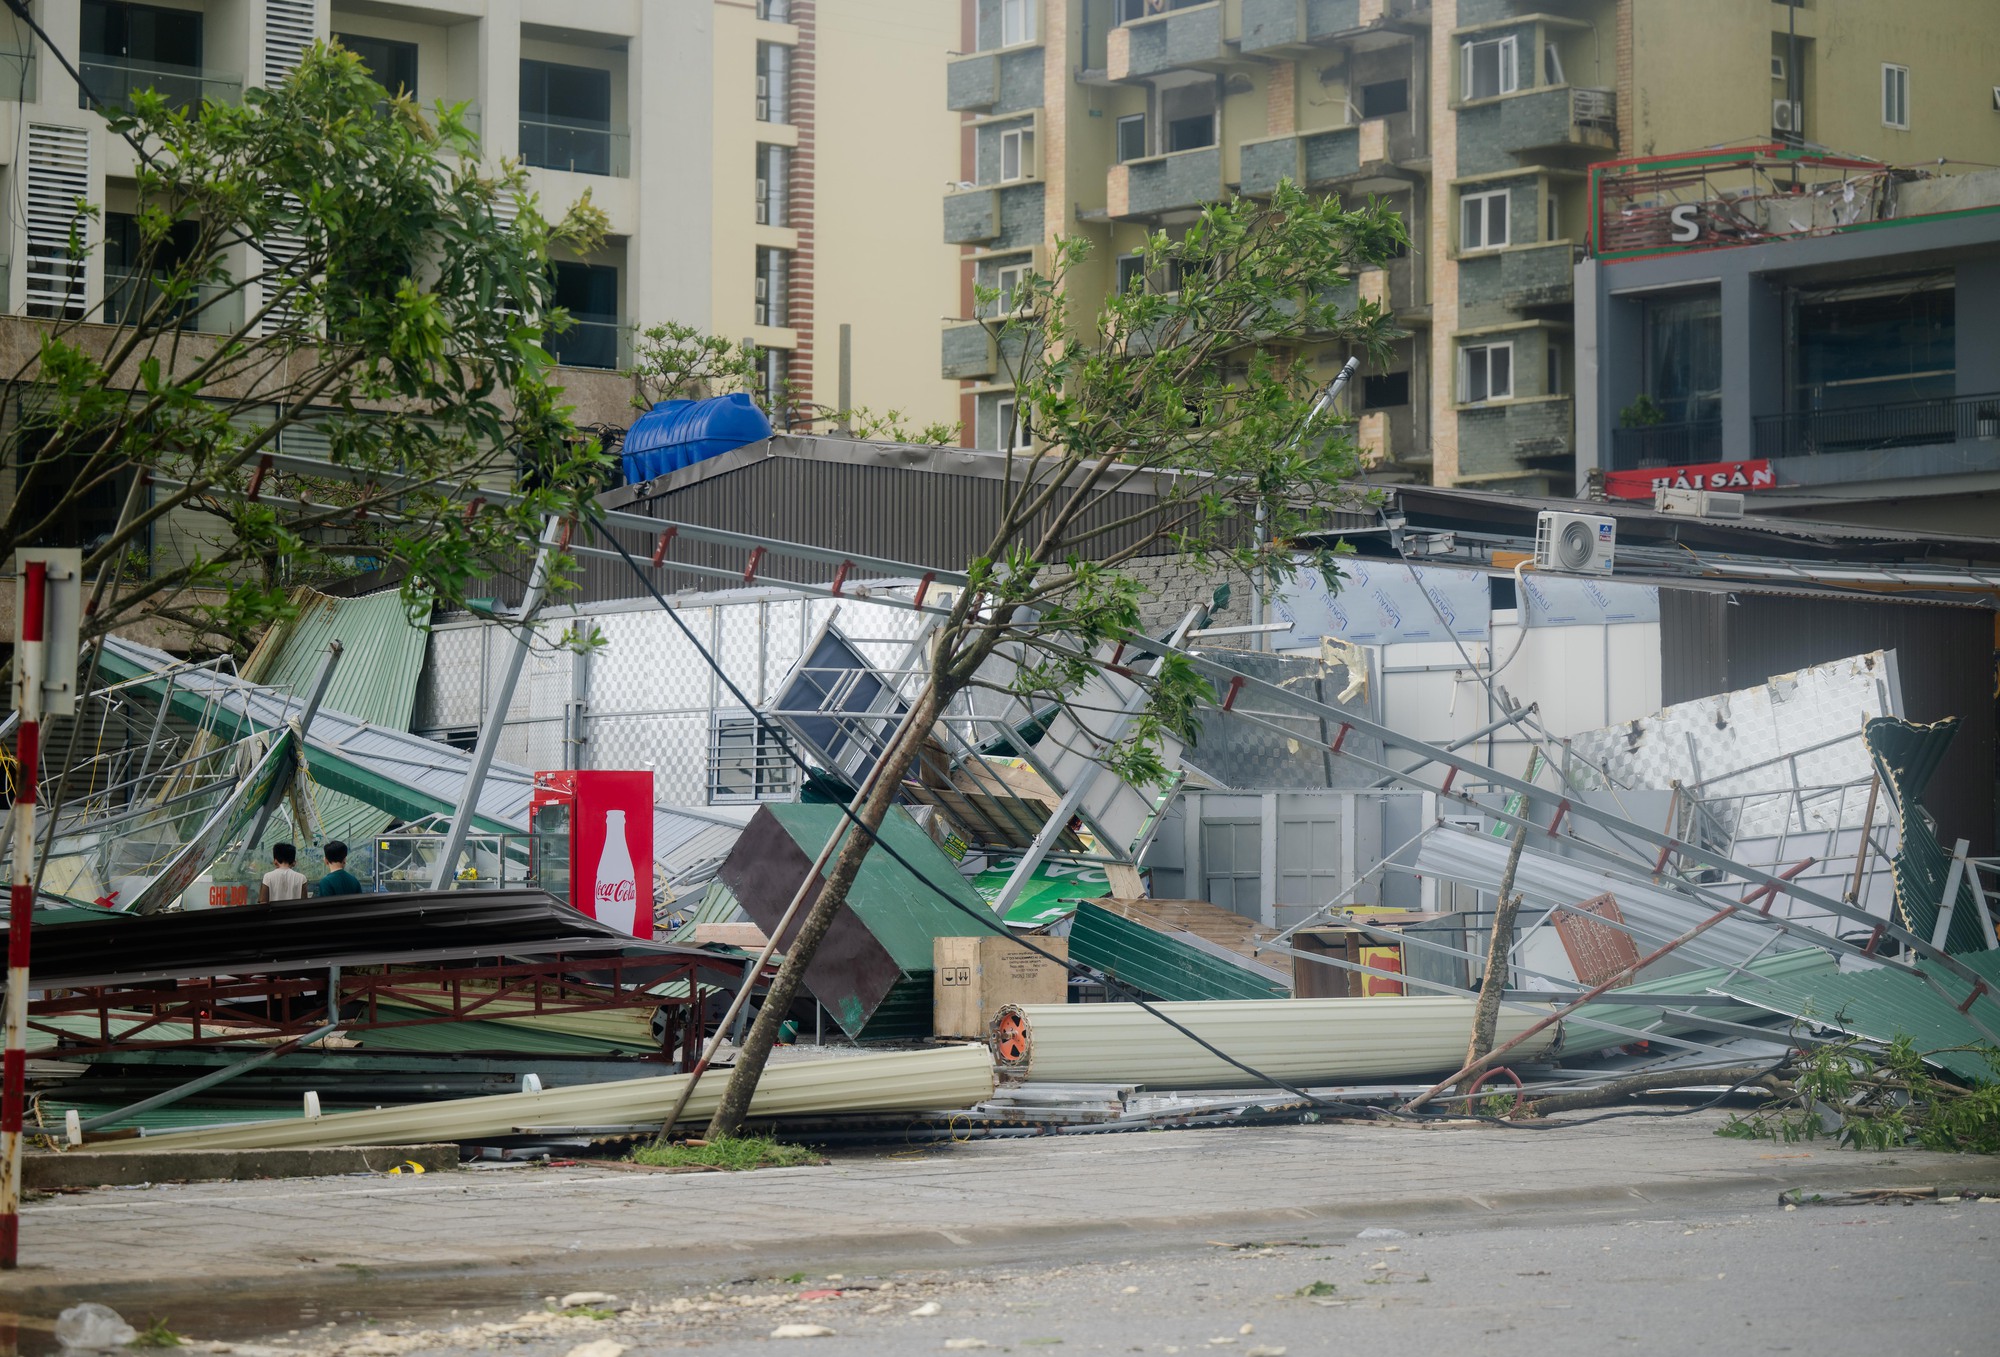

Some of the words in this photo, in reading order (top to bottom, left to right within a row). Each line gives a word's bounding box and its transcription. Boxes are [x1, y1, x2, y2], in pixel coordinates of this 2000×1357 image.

[1671, 205, 1699, 242] S
[1651, 469, 1704, 492] HẢI
[1711, 464, 1772, 488] SẢN
[1374, 590, 1401, 629] LIONALU
[1428, 588, 1455, 626] LIONALU
[1524, 574, 1551, 611] LIONALU
[1583, 579, 1610, 608] IONALU
[1321, 594, 1348, 631] LIONALU
